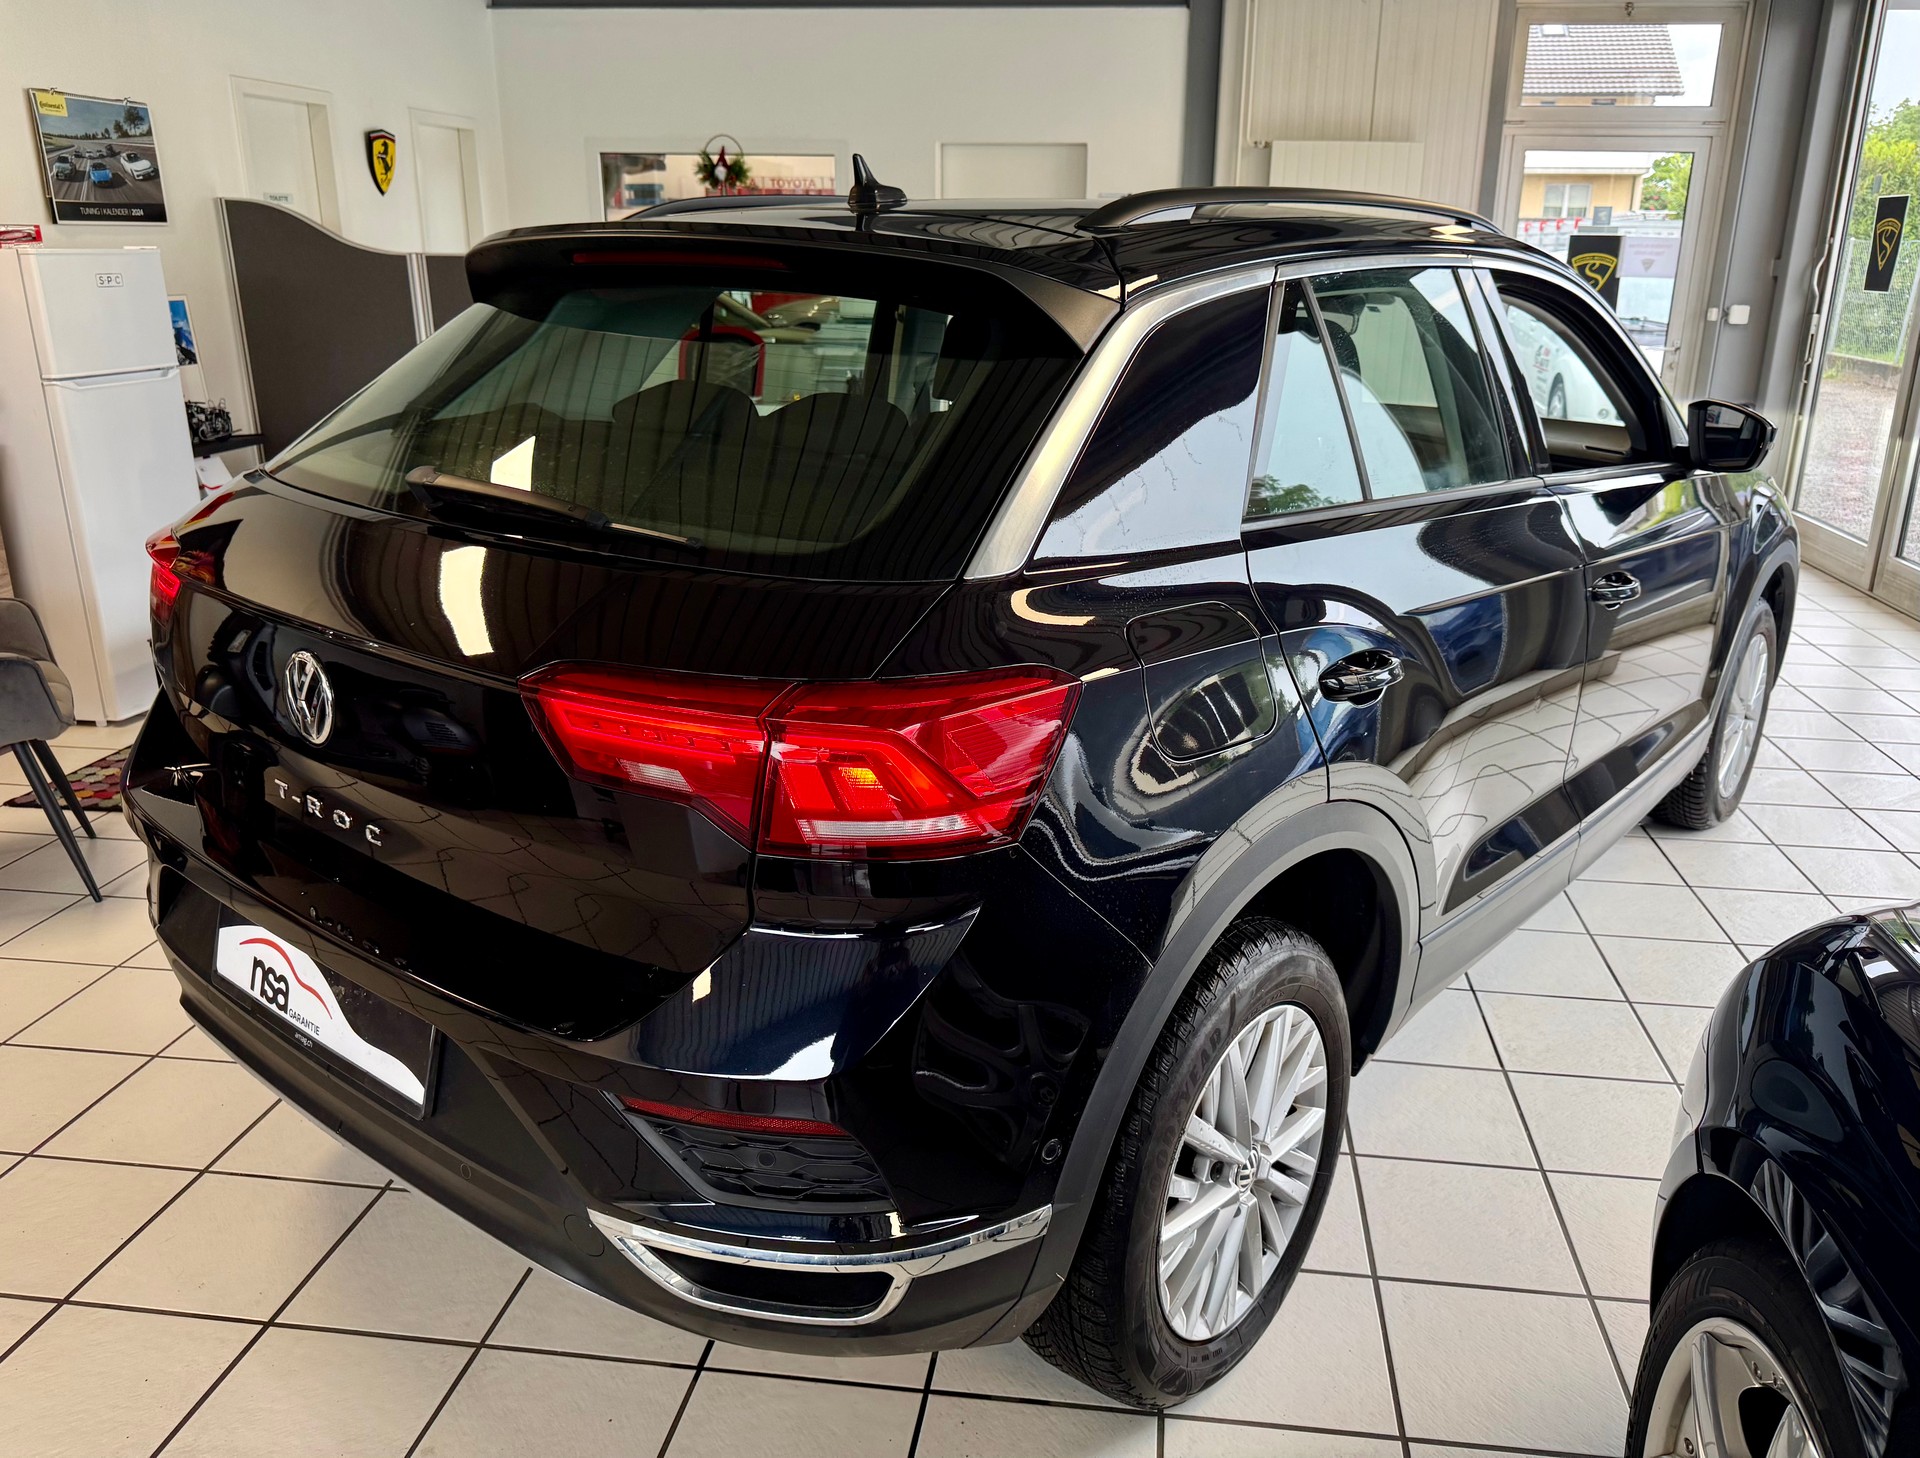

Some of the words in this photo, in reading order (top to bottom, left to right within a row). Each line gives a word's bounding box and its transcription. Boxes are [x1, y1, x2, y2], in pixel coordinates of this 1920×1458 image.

[770, 178, 816, 188] TOYOTA
[80, 207, 100, 215] TUNING
[103, 208, 129, 216] KALENDER
[250, 956, 290, 1015] nsa
[289, 1008, 320, 1036] GARANTIE
